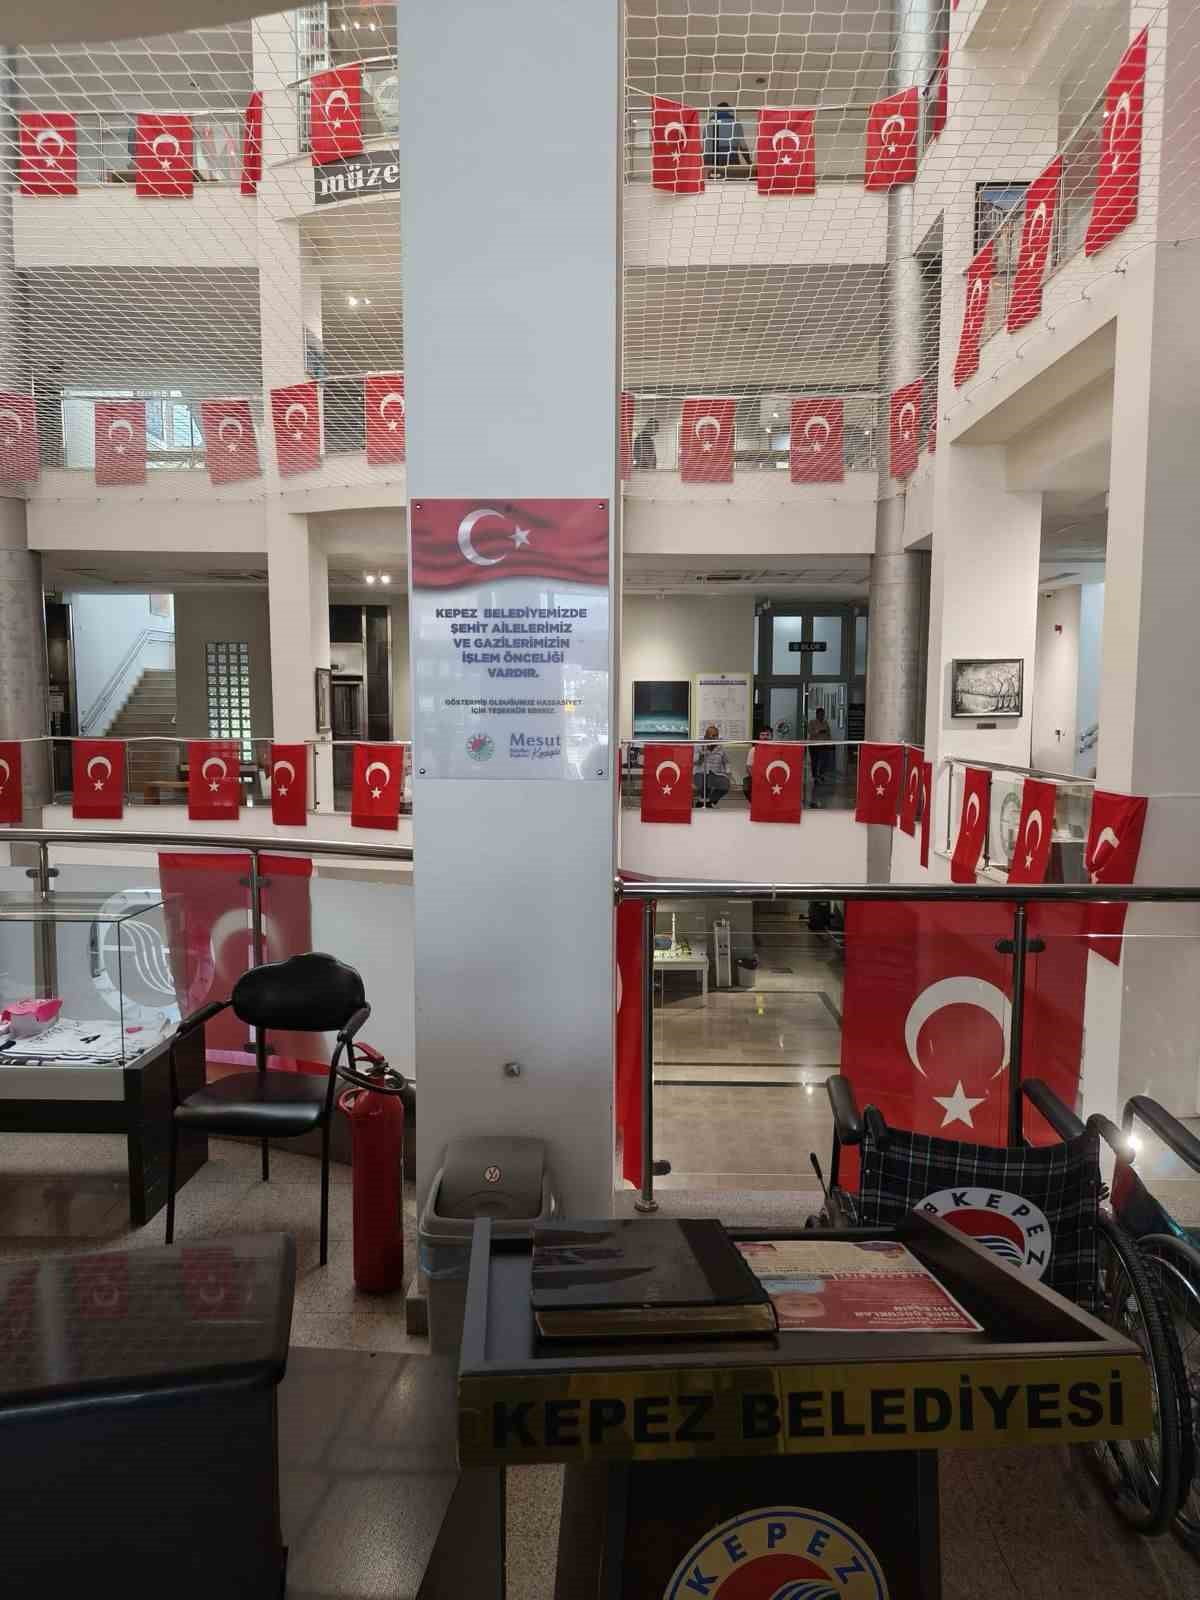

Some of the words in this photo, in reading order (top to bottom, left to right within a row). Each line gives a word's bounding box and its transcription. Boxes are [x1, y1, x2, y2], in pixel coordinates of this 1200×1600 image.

[319, 163, 400, 196] müze
[436, 608, 478, 619] KEPEZ
[483, 606, 588, 619] BELEDİYEMİZDE
[450, 621, 488, 634] ŞEHİT
[491, 621, 573, 633] AİLELERİMİZ
[453, 638, 471, 649] VE
[473, 636, 570, 649] GAZİLERİMİZİN
[462, 651, 500, 664] İŞLEM
[503, 651, 564, 664] ÖNCELİĞİ
[509, 733, 561, 747] Mesut
[951, 1192, 1045, 1266] KEPEZ
[493, 1393, 716, 1449] KEPEZ
[742, 1369, 1123, 1440] BELEDİYESİ
[685, 1522, 867, 1597] KEPEZ
